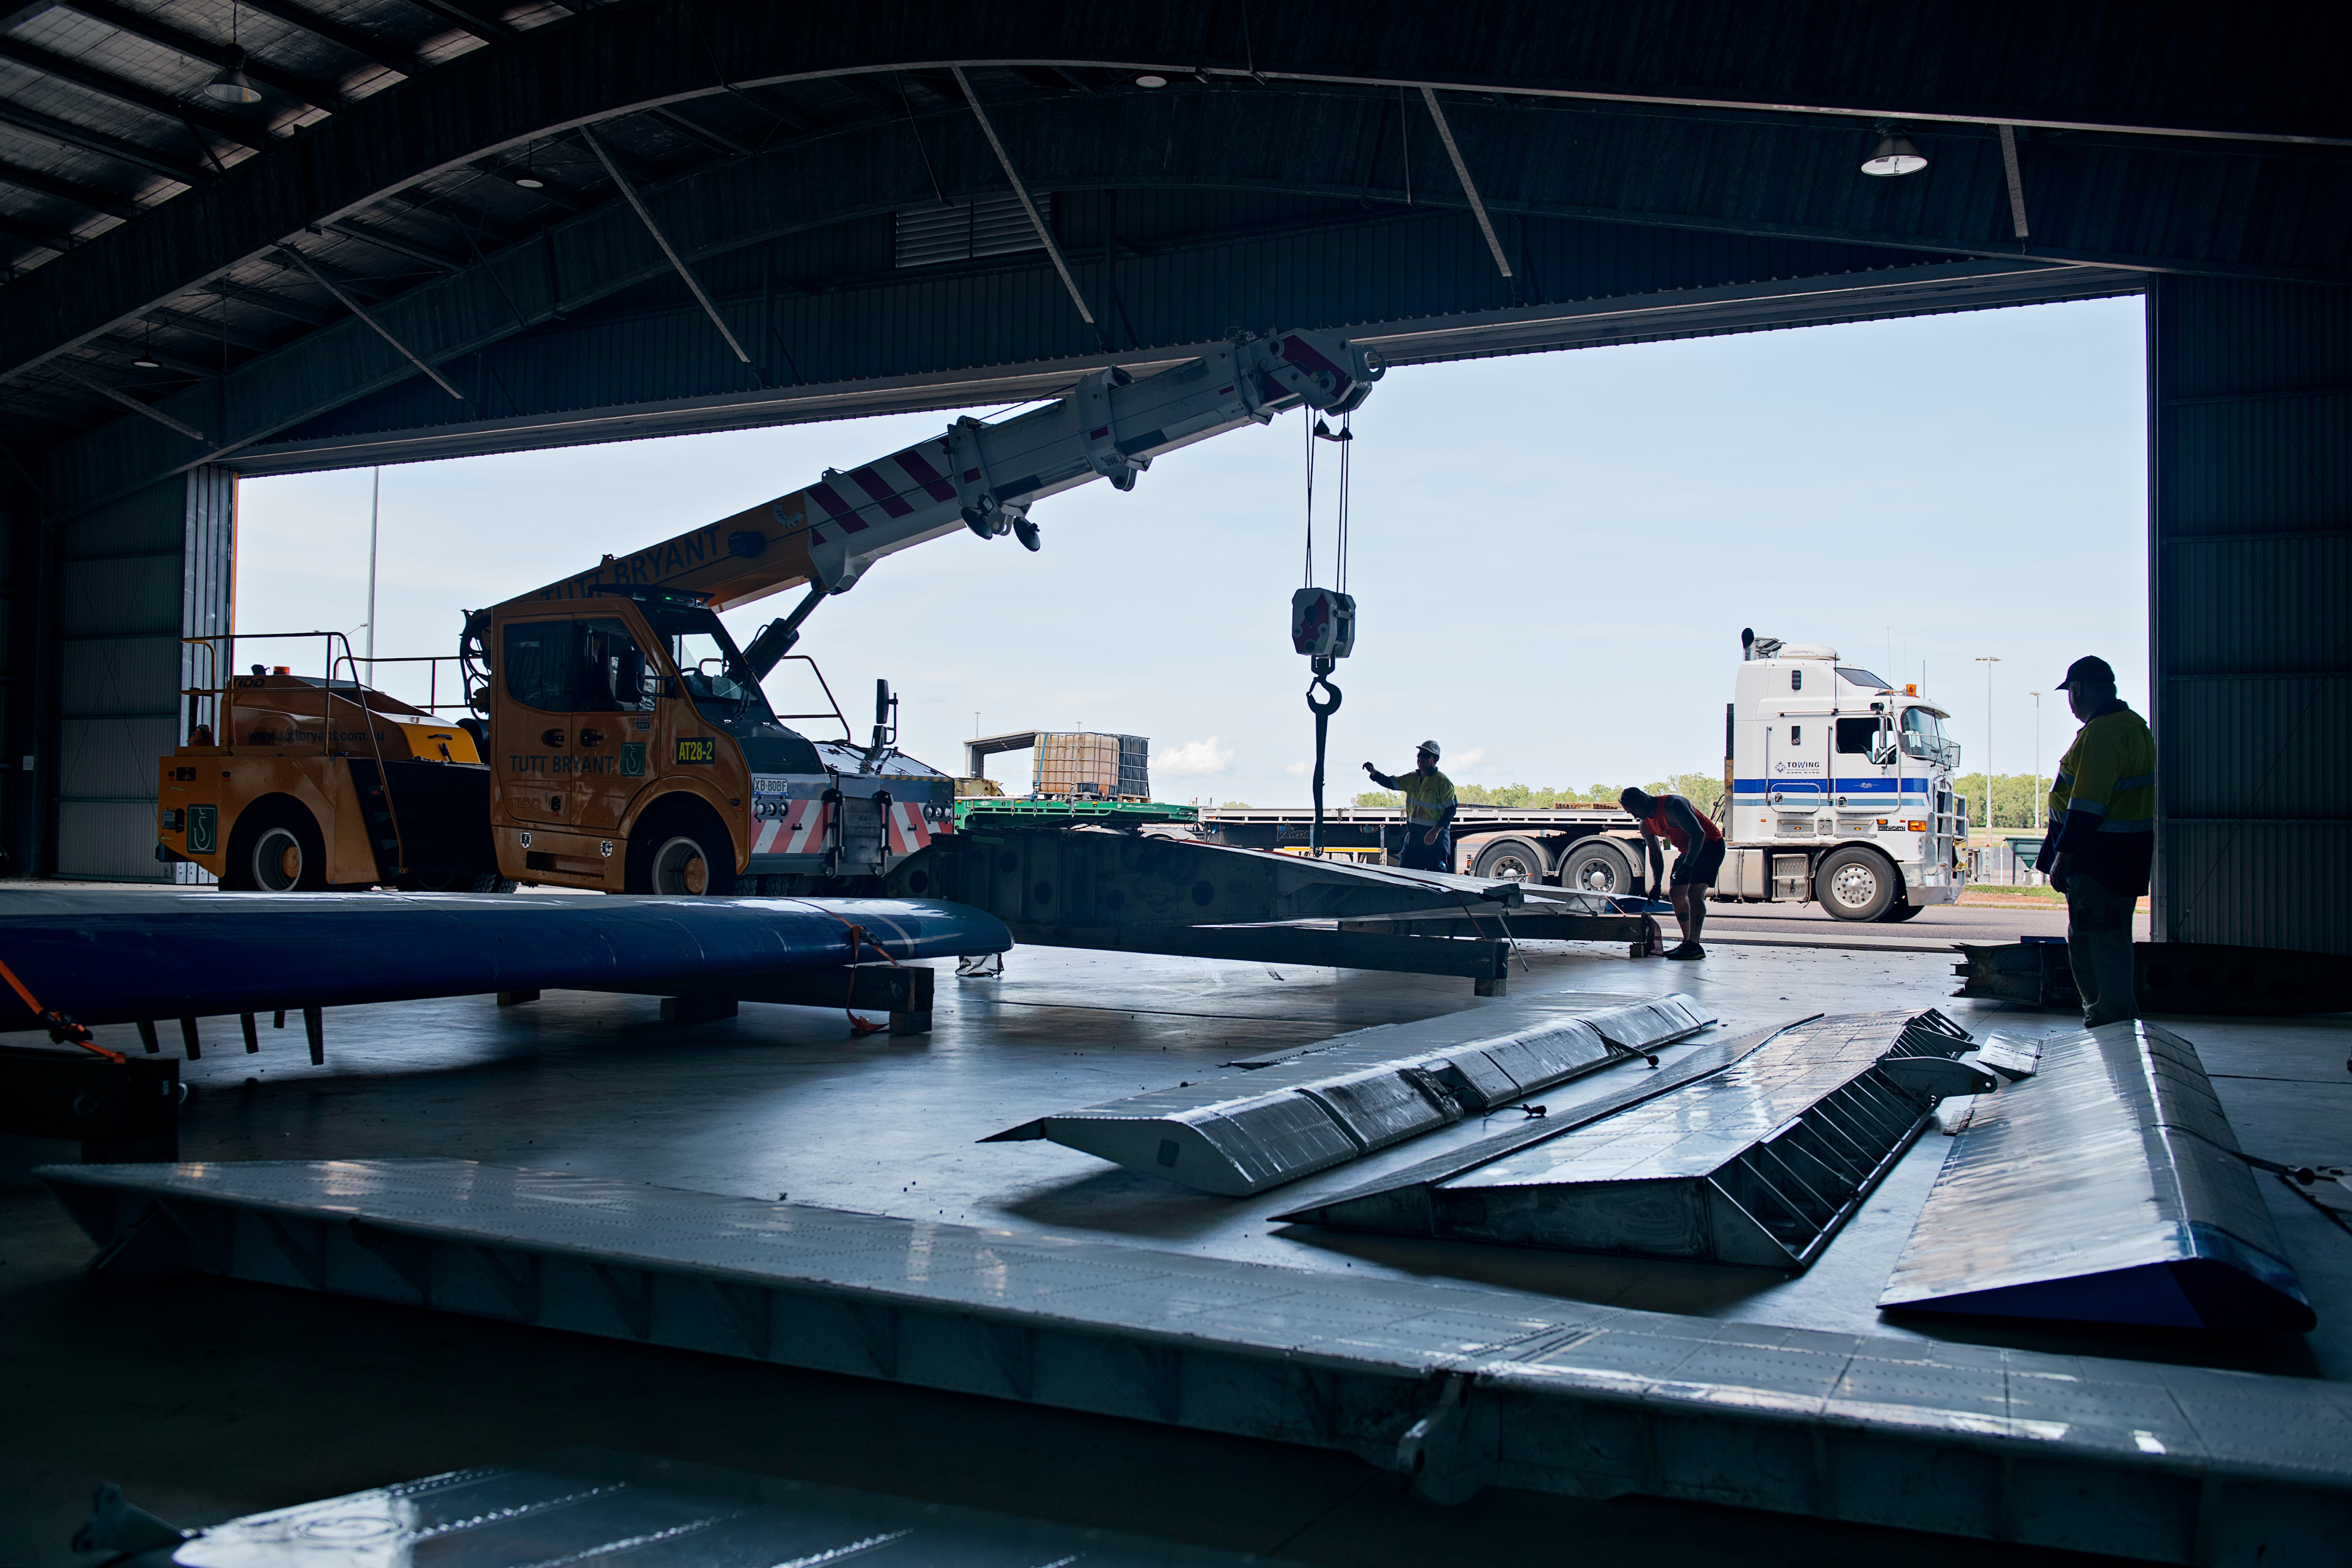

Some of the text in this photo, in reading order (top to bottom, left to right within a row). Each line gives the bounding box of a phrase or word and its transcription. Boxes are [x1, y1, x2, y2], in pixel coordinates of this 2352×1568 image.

[613, 525, 720, 585] BRYANT
[678, 741, 713, 761] AT28-2
[509, 756, 614, 773] TUTT BRYANT
[1276, 826, 1327, 842] VAWDR
